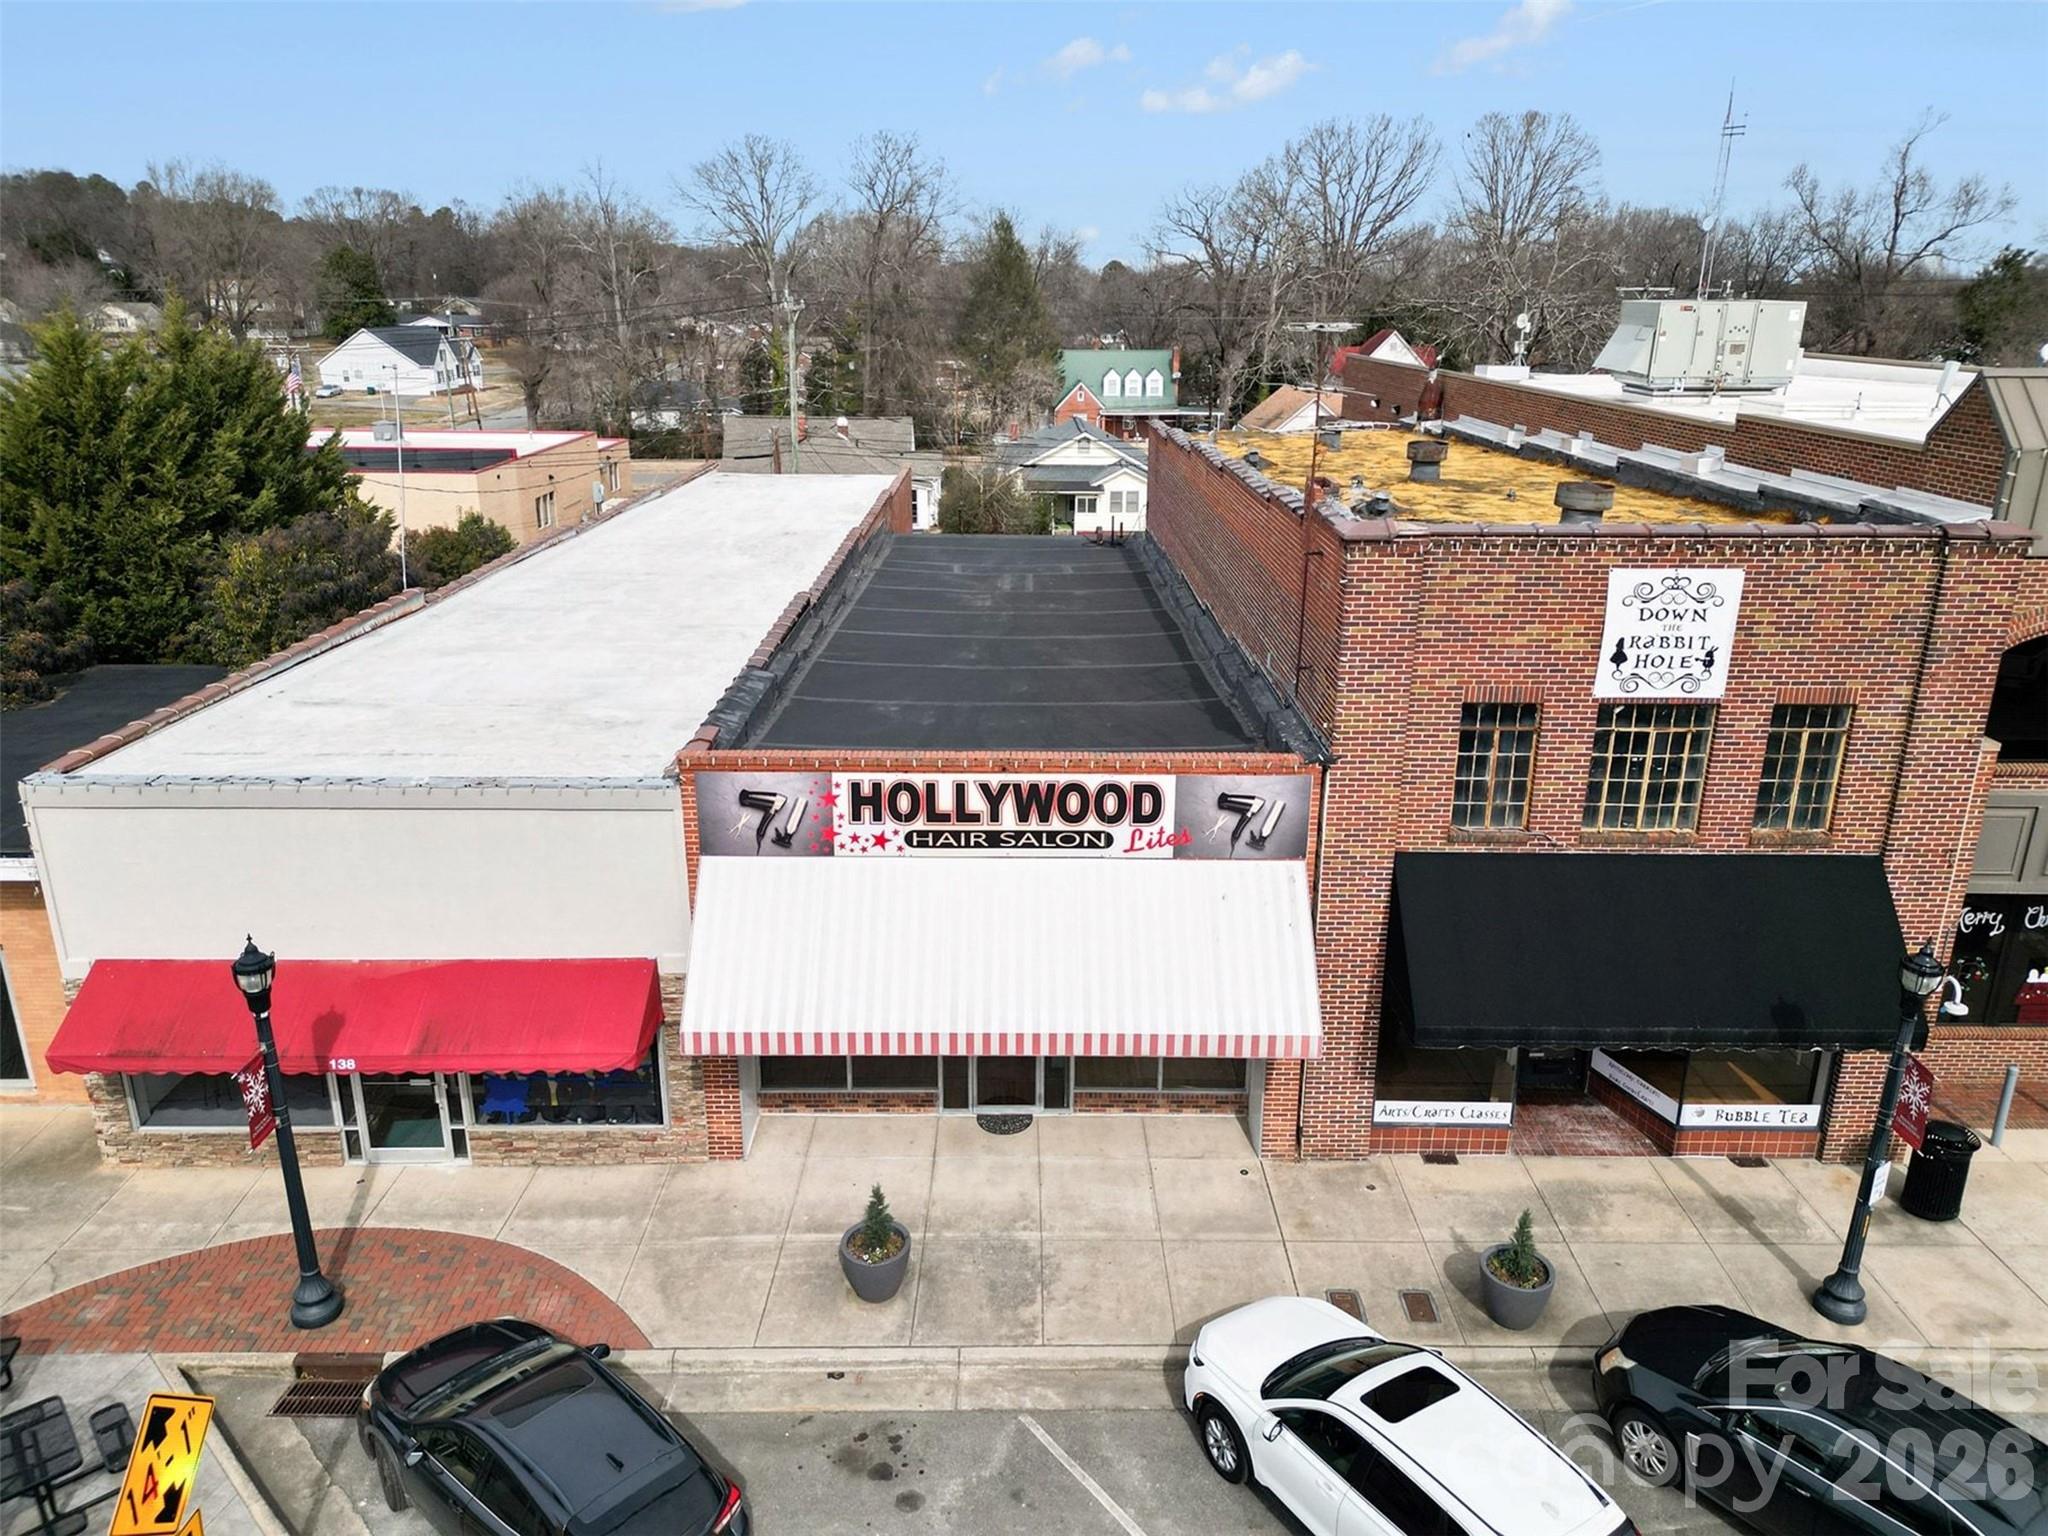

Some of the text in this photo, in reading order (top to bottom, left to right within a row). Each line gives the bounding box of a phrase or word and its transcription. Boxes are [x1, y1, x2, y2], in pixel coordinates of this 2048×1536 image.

[1639, 607, 1708, 622] DOWN
[1634, 654, 1694, 669] HOLE
[848, 778, 1166, 827] HOLLYWOOD
[911, 832, 1106, 848] HAIR SALON
[1123, 827, 1193, 853] Lites
[329, 1059, 356, 1070] 138
